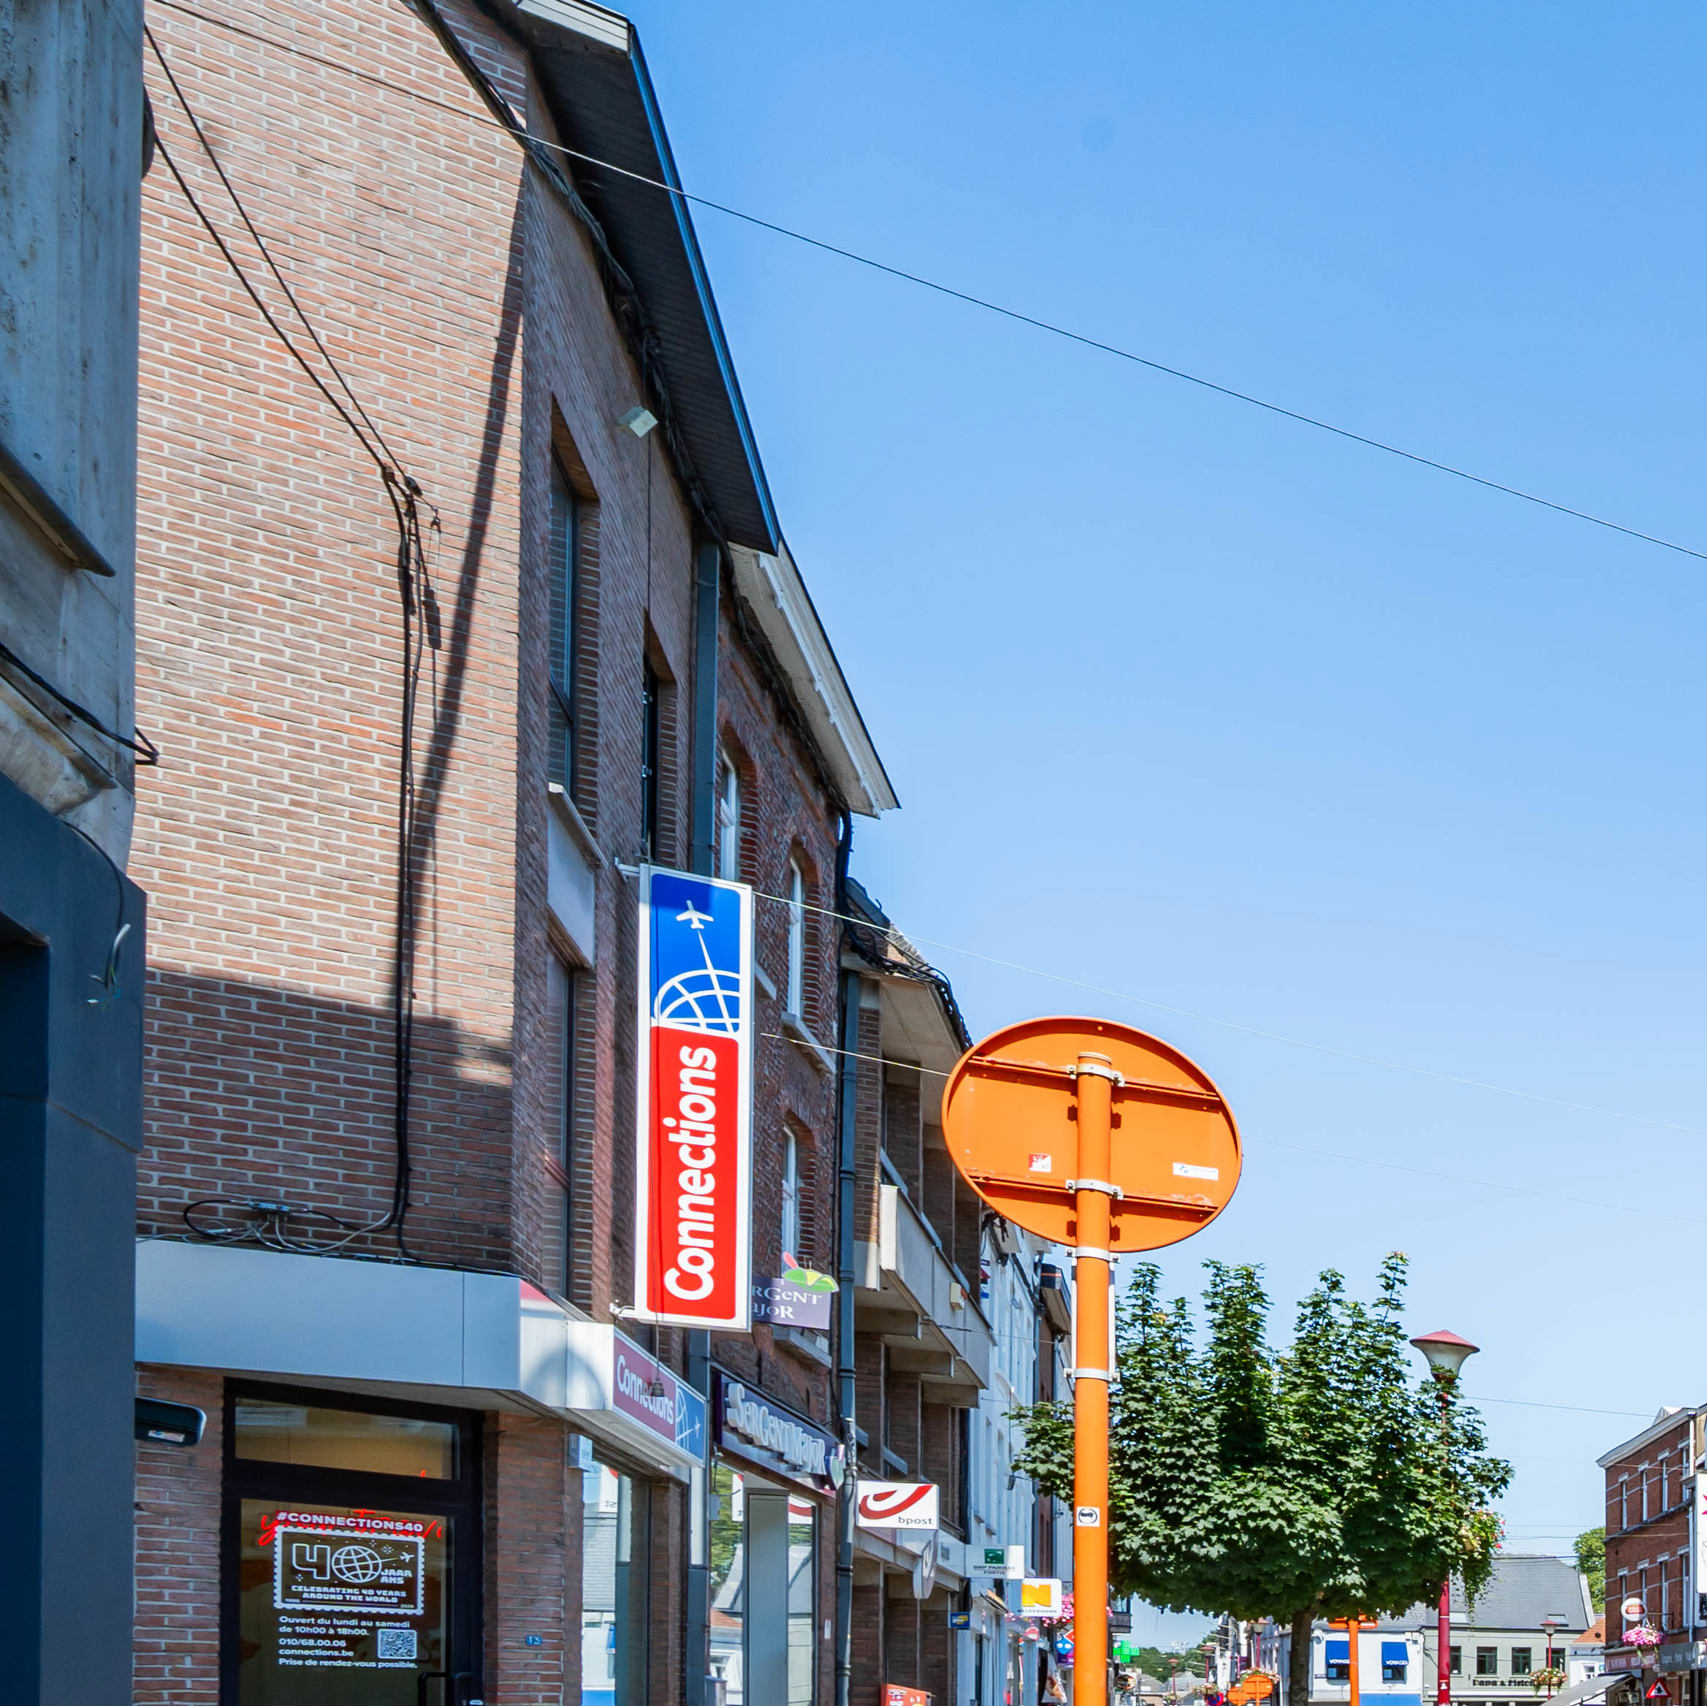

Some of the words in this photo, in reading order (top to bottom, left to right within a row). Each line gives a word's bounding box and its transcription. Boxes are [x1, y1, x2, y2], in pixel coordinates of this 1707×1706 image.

[663, 1045, 718, 1302] Connections
[276, 1511, 424, 1532] #CONNECTIONS40
[898, 1516, 933, 1526] bpost
[291, 1585, 360, 1596] CELEBRATING
[376, 1589, 407, 1598] YEARS
[302, 1592, 344, 1601] AROUND
[345, 1594, 363, 1602] THE
[364, 1595, 399, 1604] WORLD
[279, 1615, 315, 1626] Ouvert
[316, 1616, 330, 1626] du
[333, 1616, 359, 1627] lundi
[360, 1619, 374, 1627] au
[375, 1619, 411, 1629] samedi
[279, 1625, 292, 1634] de
[294, 1626, 327, 1635] 10h00
[278, 1648, 355, 1658] connections.be
[278, 1658, 303, 1667] Prise
[304, 1659, 318, 1667] de
[319, 1660, 377, 1669] rendez-vous
